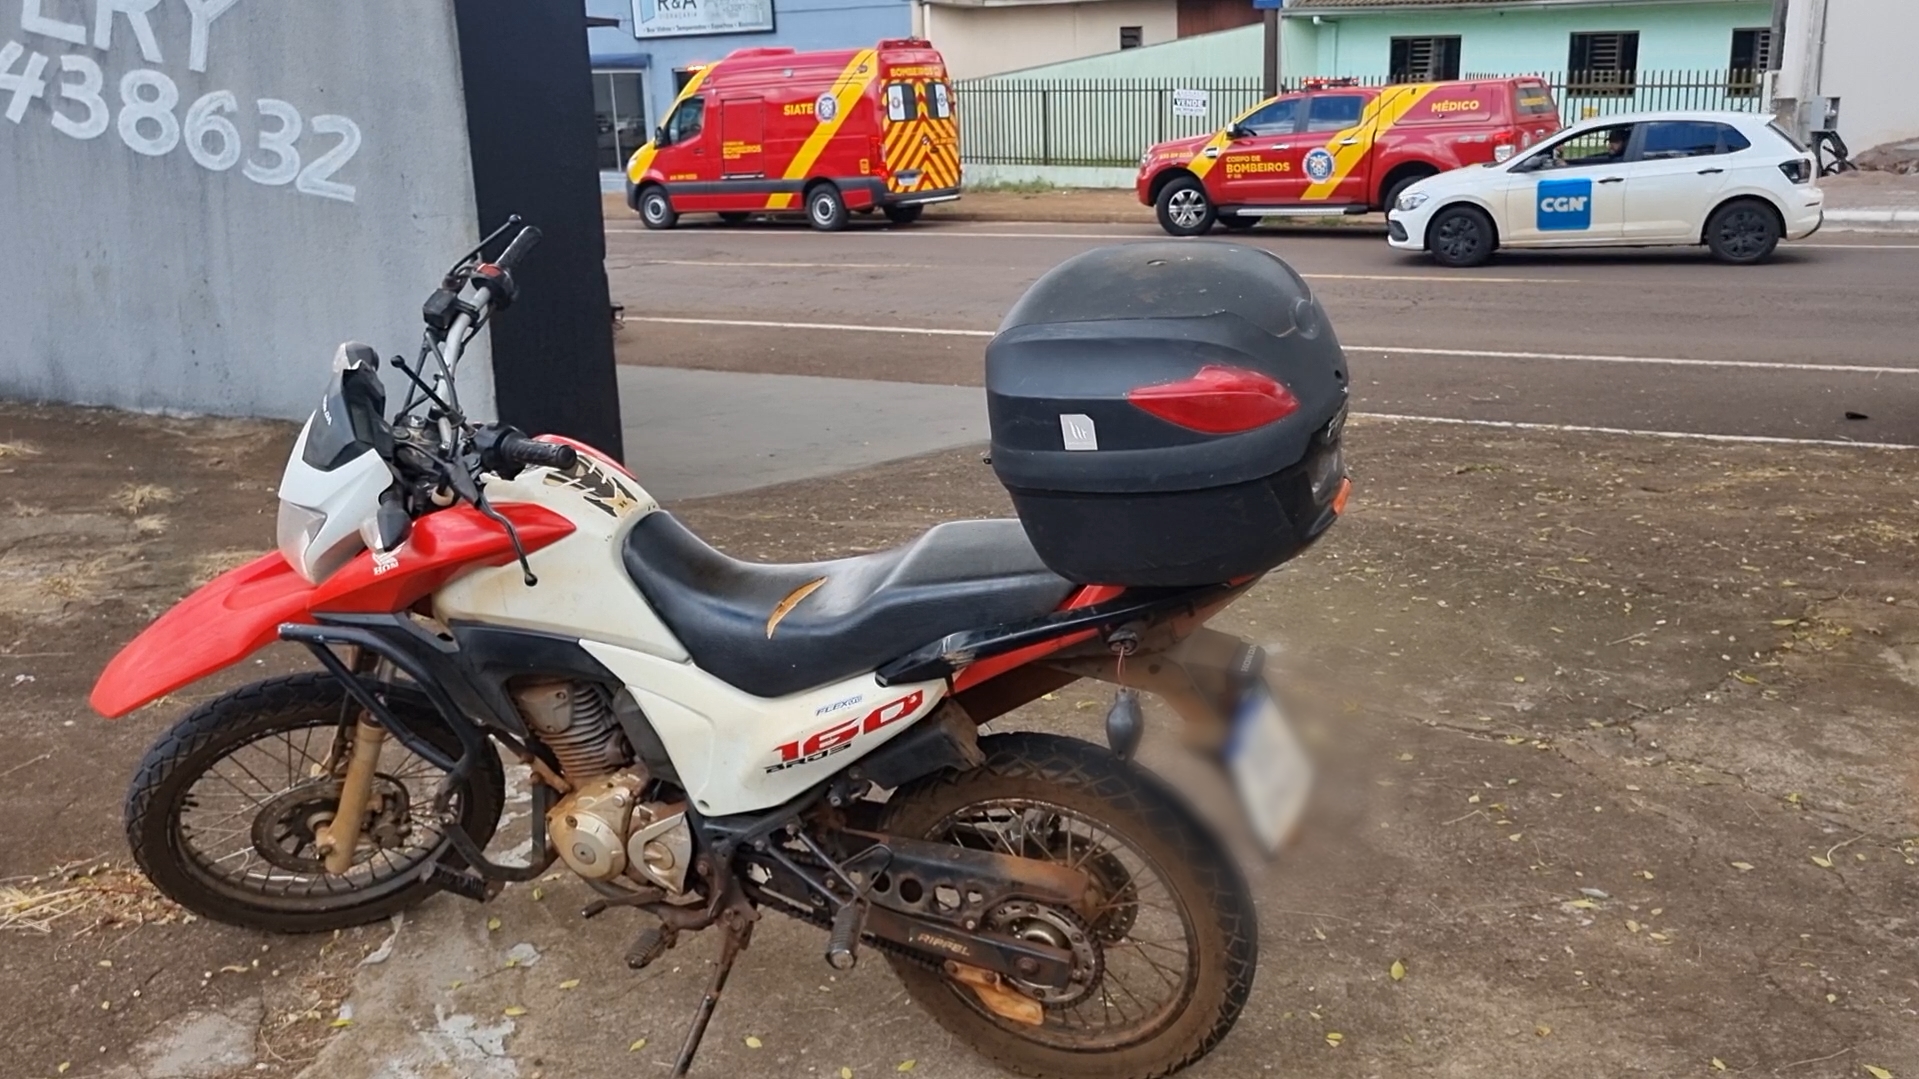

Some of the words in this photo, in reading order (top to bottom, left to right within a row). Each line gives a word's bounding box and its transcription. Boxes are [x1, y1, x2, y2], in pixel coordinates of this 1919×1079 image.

[657, 0, 697, 11] R&A
[783, 103, 814, 116] SIATE
[1431, 100, 1480, 112] MÉDICO
[1226, 162, 1290, 173] BOMBEIROS
[1541, 196, 1588, 212] CGN
[772, 690, 923, 762] 160
[763, 743, 851, 774] BROS
